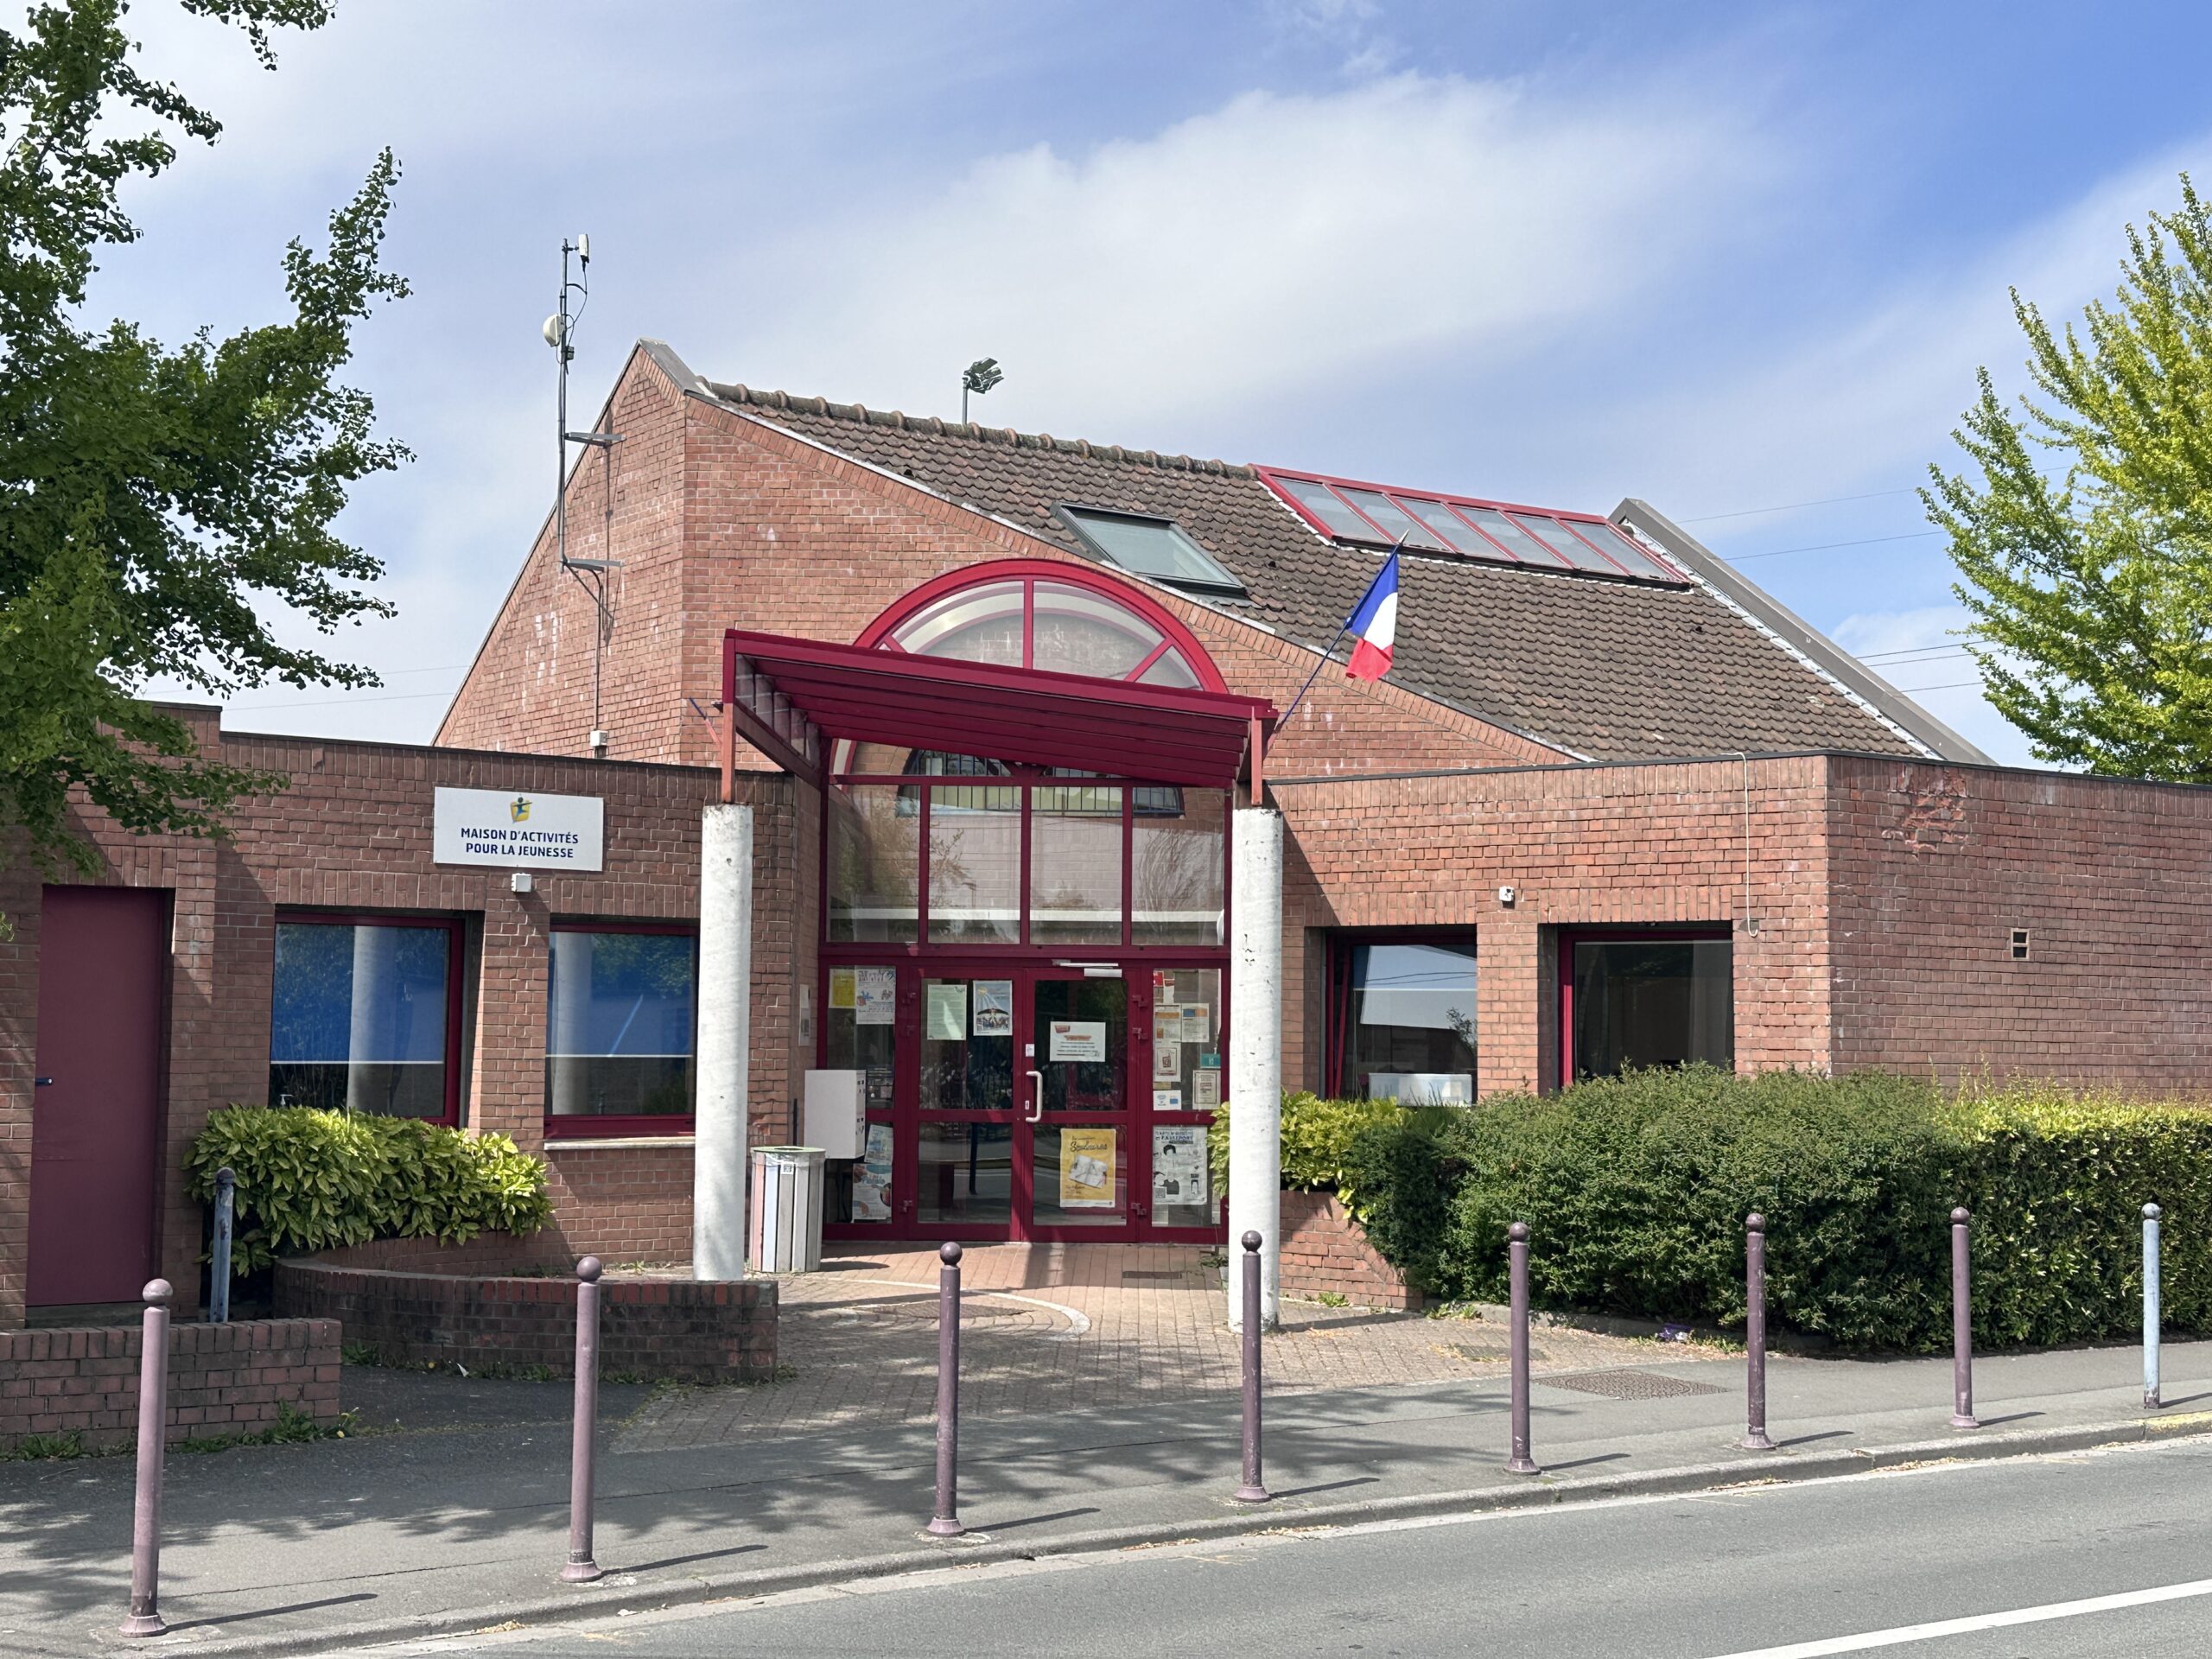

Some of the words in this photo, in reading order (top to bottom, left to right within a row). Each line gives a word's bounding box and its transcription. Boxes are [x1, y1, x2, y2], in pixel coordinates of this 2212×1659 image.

[461, 828, 506, 841] MAISON
[510, 830, 579, 844] D'ACTIVITÉS
[466, 842, 498, 854] POUR
[501, 844, 515, 855] LA
[518, 845, 574, 858] JEUNESSE
